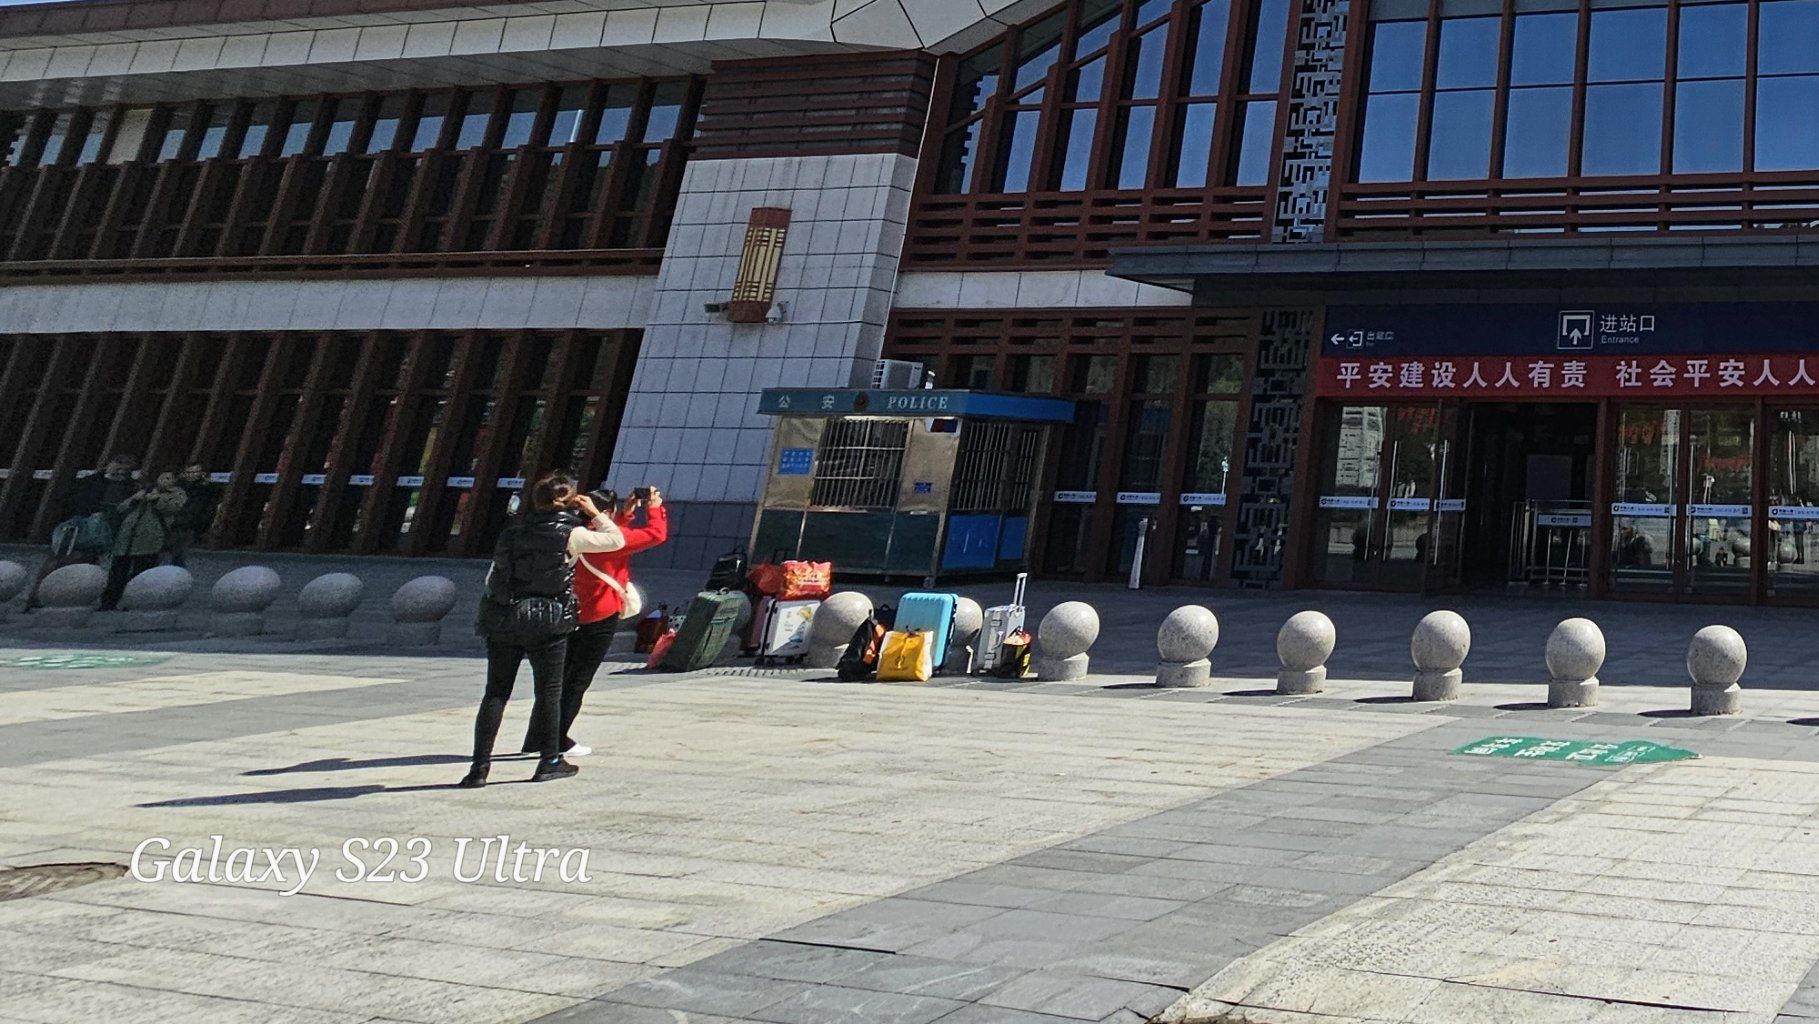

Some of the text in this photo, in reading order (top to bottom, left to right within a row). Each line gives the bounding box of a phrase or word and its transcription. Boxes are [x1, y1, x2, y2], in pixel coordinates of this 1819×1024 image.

[1600, 314, 1655, 333] 进站口
[1601, 335, 1640, 344] Entrance
[1336, 360, 1588, 388] 平安建设人人有责
[887, 395, 949, 410] POLICE
